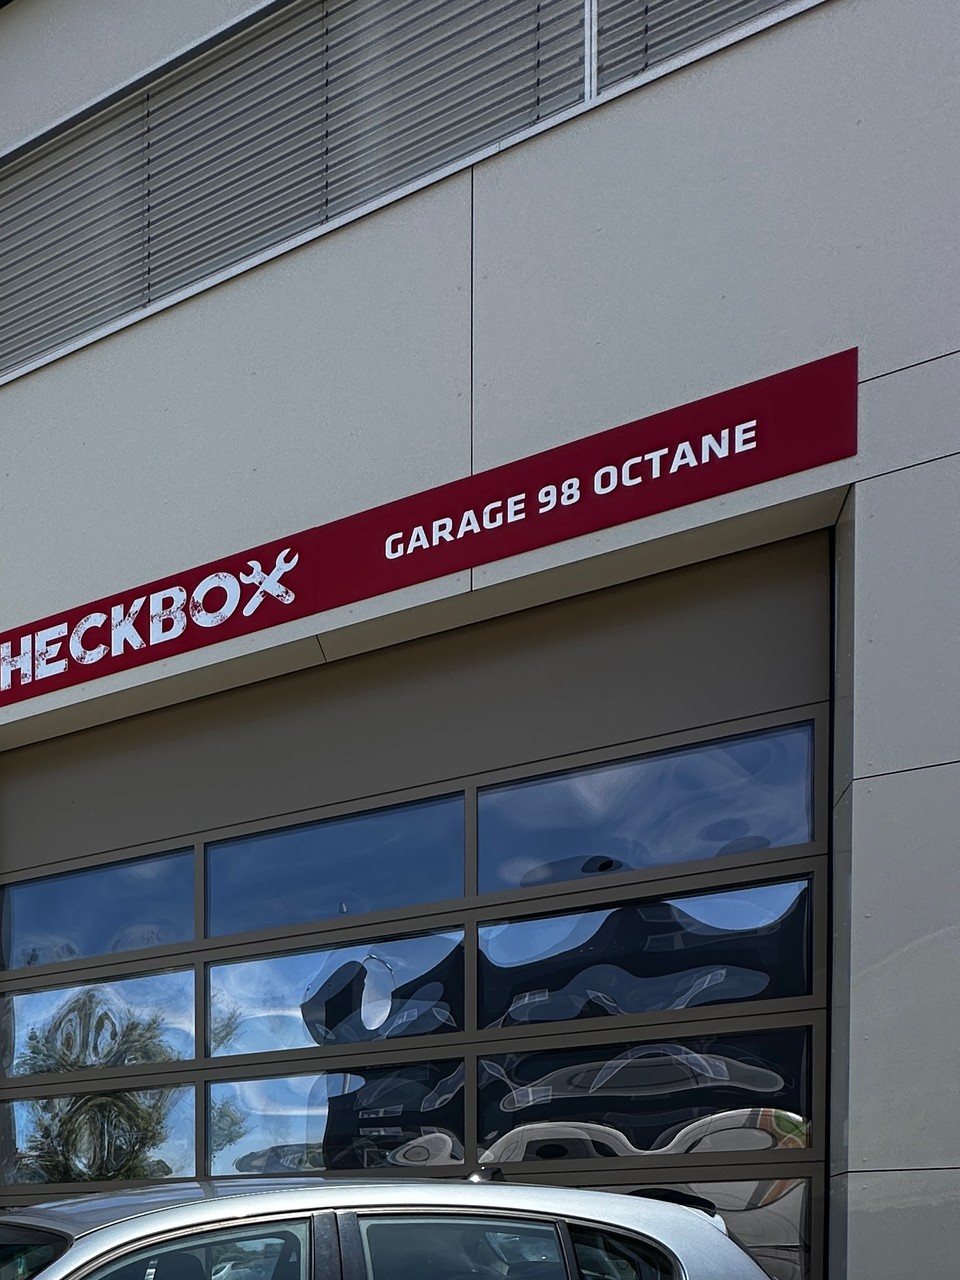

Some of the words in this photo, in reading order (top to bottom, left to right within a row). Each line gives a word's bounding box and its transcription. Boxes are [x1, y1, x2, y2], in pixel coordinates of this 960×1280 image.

[385, 492, 526, 560] GARAGE
[538, 477, 581, 514] 98
[593, 419, 757, 495] OCTANE
